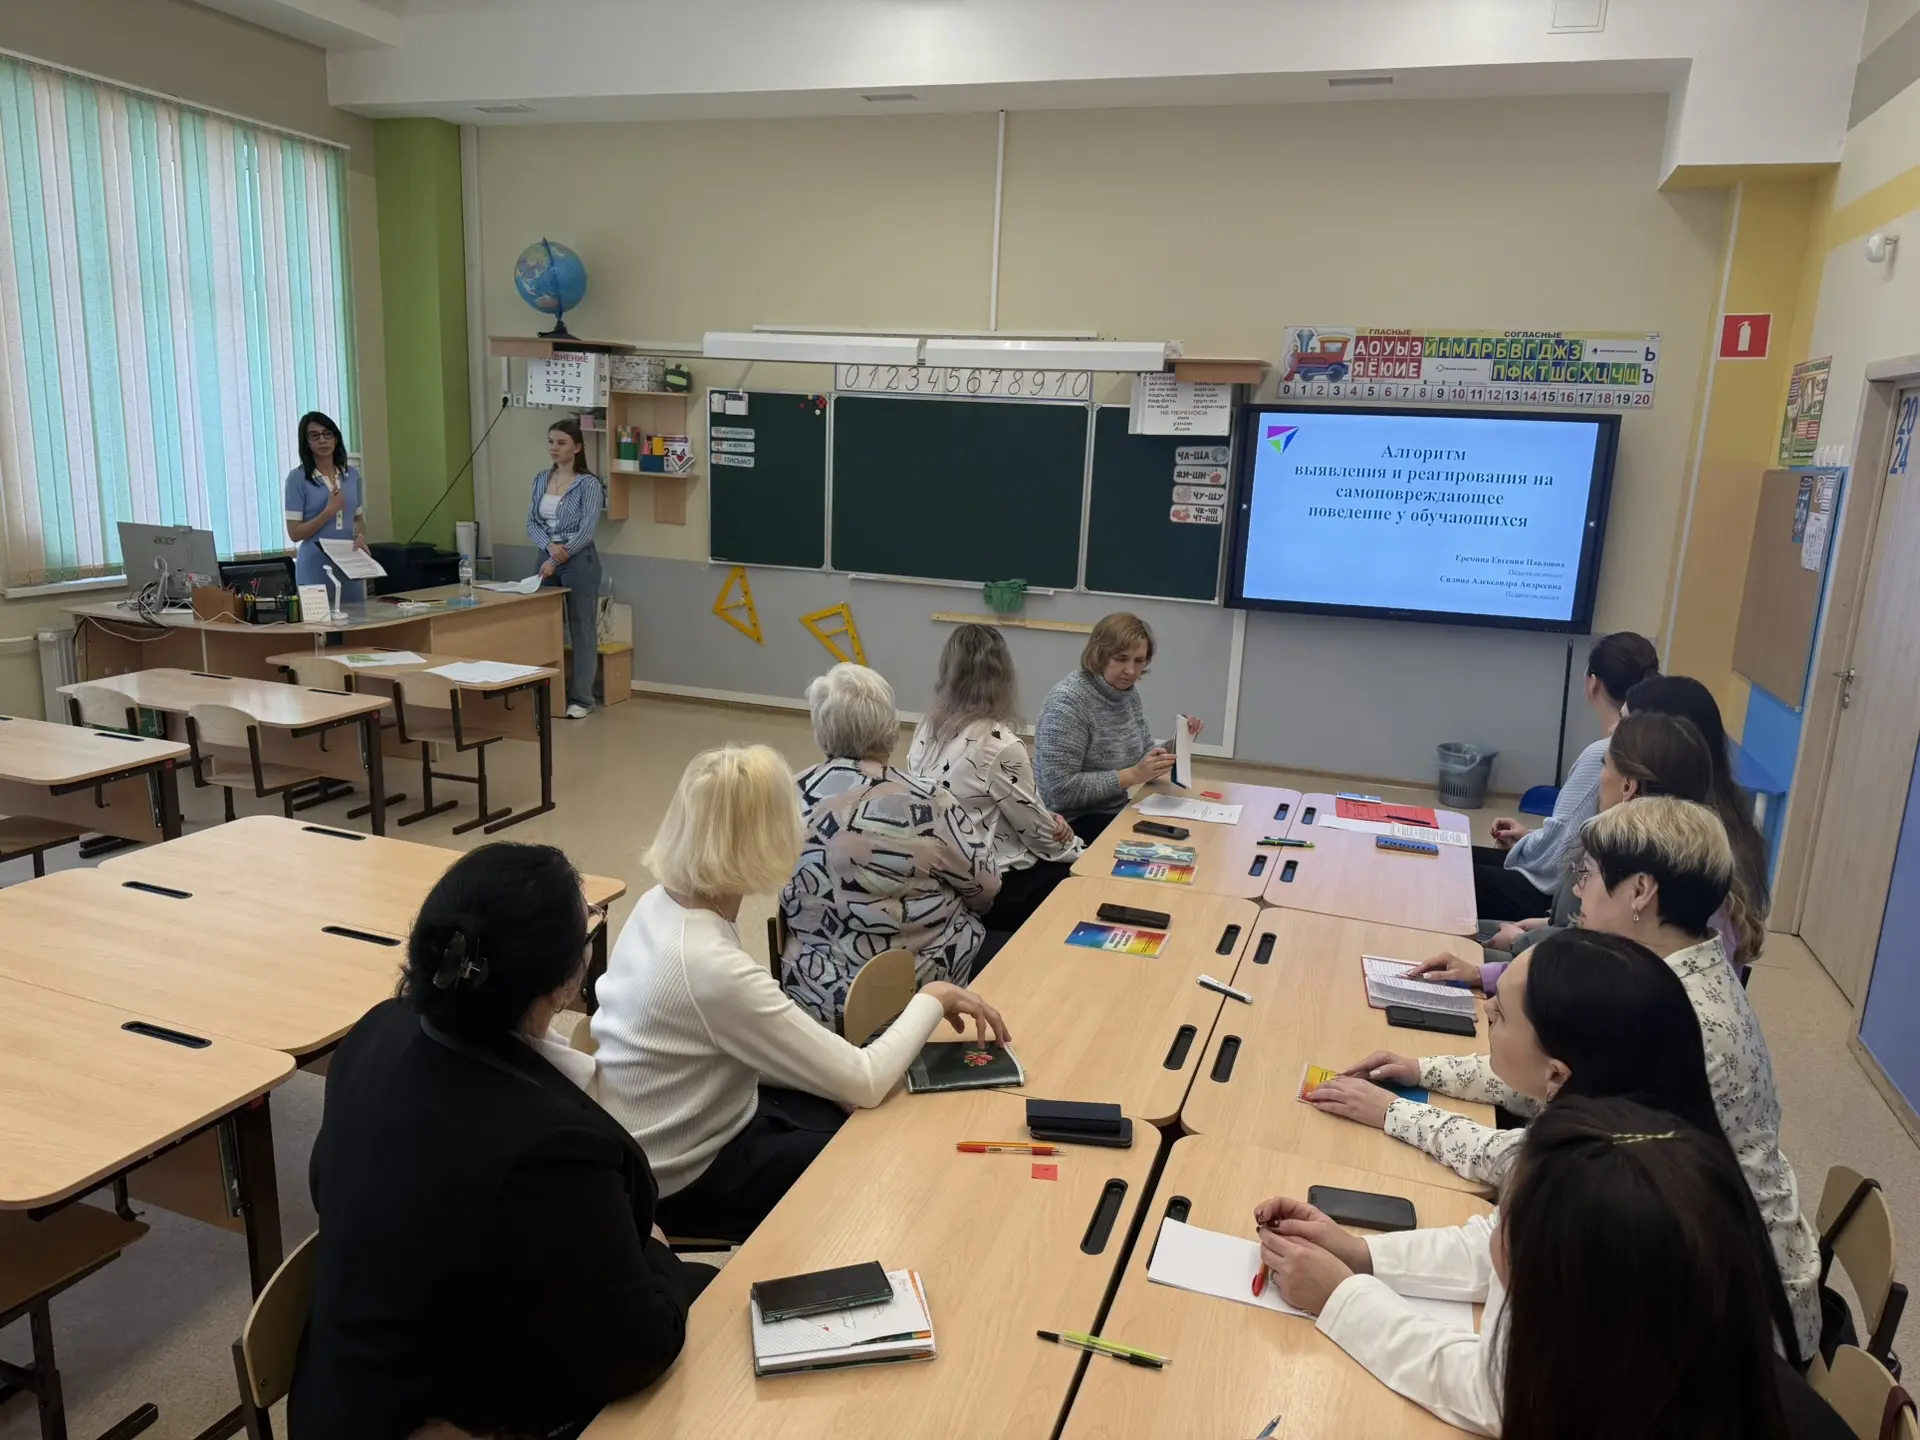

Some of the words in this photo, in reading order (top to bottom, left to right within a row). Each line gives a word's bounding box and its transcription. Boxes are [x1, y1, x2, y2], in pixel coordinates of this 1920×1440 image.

[845, 364, 859, 388] 0
[869, 366, 878, 388] 1
[885, 366, 899, 390] 2
[906, 367, 920, 390] 3
[928, 368, 939, 392] 4
[946, 368, 960, 393] 5
[966, 368, 982, 393] 6
[988, 370, 1002, 394] 7
[1008, 370, 1023, 395] 8
[1030, 371, 1045, 396] 9
[1283, 385, 1290, 394] 0
[1301, 385, 1306, 394] 1
[1317, 386, 1324, 395] 2
[1334, 386, 1340, 395] 3
[1350, 387, 1357, 396] 4
[1368, 387, 1374, 396] 5
[1385, 387, 1391, 397] 6
[1402, 388, 1409, 397] 7
[1420, 388, 1426, 398] 8
[1437, 388, 1444, 398] 9
[1452, 389, 1465, 399] 10
[1470, 390, 1482, 399] 11
[1488, 390, 1500, 400] 12
[1506, 390, 1519, 400] 13
[1523, 391, 1536, 401] 14
[1541, 392, 1555, 401] 15
[1560, 392, 1574, 402] 16
[1579, 393, 1592, 402] 17
[1597, 393, 1611, 403] 18
[1616, 394, 1630, 404] 19
[1635, 394, 1649, 404] 20
[1898, 396, 1918, 435] 20
[724, 456, 751, 465] ПИСЬМО
[1178, 451, 1210, 460] ЧА-ЩА
[1381, 444, 1466, 463] Алгоритм
[1889, 436, 1911, 474] 24
[1176, 471, 1206, 479] ЖИ-ШИ
[1294, 465, 1386, 479] выявления
[1392, 469, 1402, 479] и
[1407, 469, 1527, 486] реагирования
[1534, 474, 1553, 486] на
[1193, 492, 1223, 500] ЧУ-ЩУ
[1336, 486, 1504, 506] самоповреждающее
[1308, 506, 1392, 521] поведение
[1396, 511, 1406, 524] у
[1410, 508, 1528, 528] обучающихся
[154, 536, 177, 545] acer
[1455, 554, 1489, 563] Еремина
[1526, 558, 1565, 568] Павловна
[1472, 578, 1518, 588] Александра
